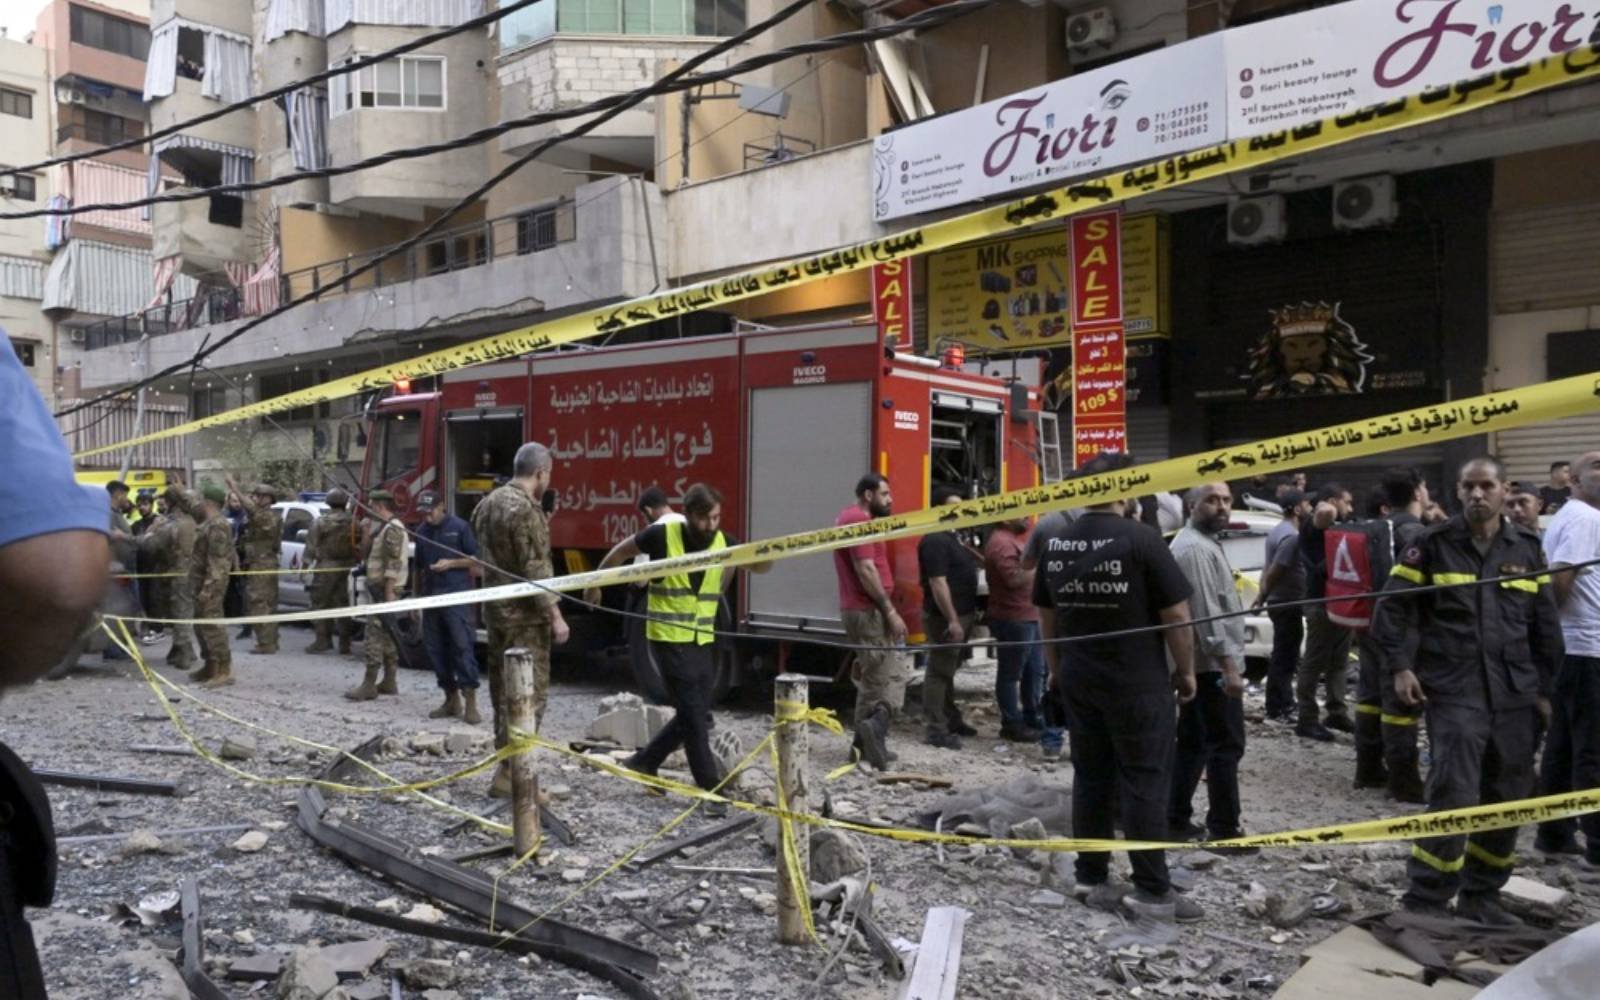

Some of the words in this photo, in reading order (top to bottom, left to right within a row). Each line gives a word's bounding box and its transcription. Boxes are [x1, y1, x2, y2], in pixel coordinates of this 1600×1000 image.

[1284, 76, 1319, 89] beauty
[1321, 67, 1358, 80] lounge
[983, 91, 1119, 178] Fiori
[977, 243, 1011, 271] MK
[1081, 218, 1110, 319] SALE
[1102, 345, 1109, 358] 3
[793, 365, 827, 377] IVECO
[549, 384, 597, 415] الجنوبية
[597, 379, 642, 412] الضاحية
[643, 374, 685, 408] بلديات
[1079, 393, 1106, 413] 109
[1107, 388, 1118, 403] $
[1407, 407, 1466, 435] الوقوف
[1469, 397, 1520, 425] ممنوع
[1367, 416, 1403, 439] تحت
[547, 427, 620, 469] الضاحية
[673, 421, 714, 469] فوج
[1077, 443, 1090, 455] 50
[1078, 478, 1117, 498] الوقوف
[1047, 536, 1088, 552] There
[1047, 560, 1063, 573] no
[1089, 580, 1129, 594] now
